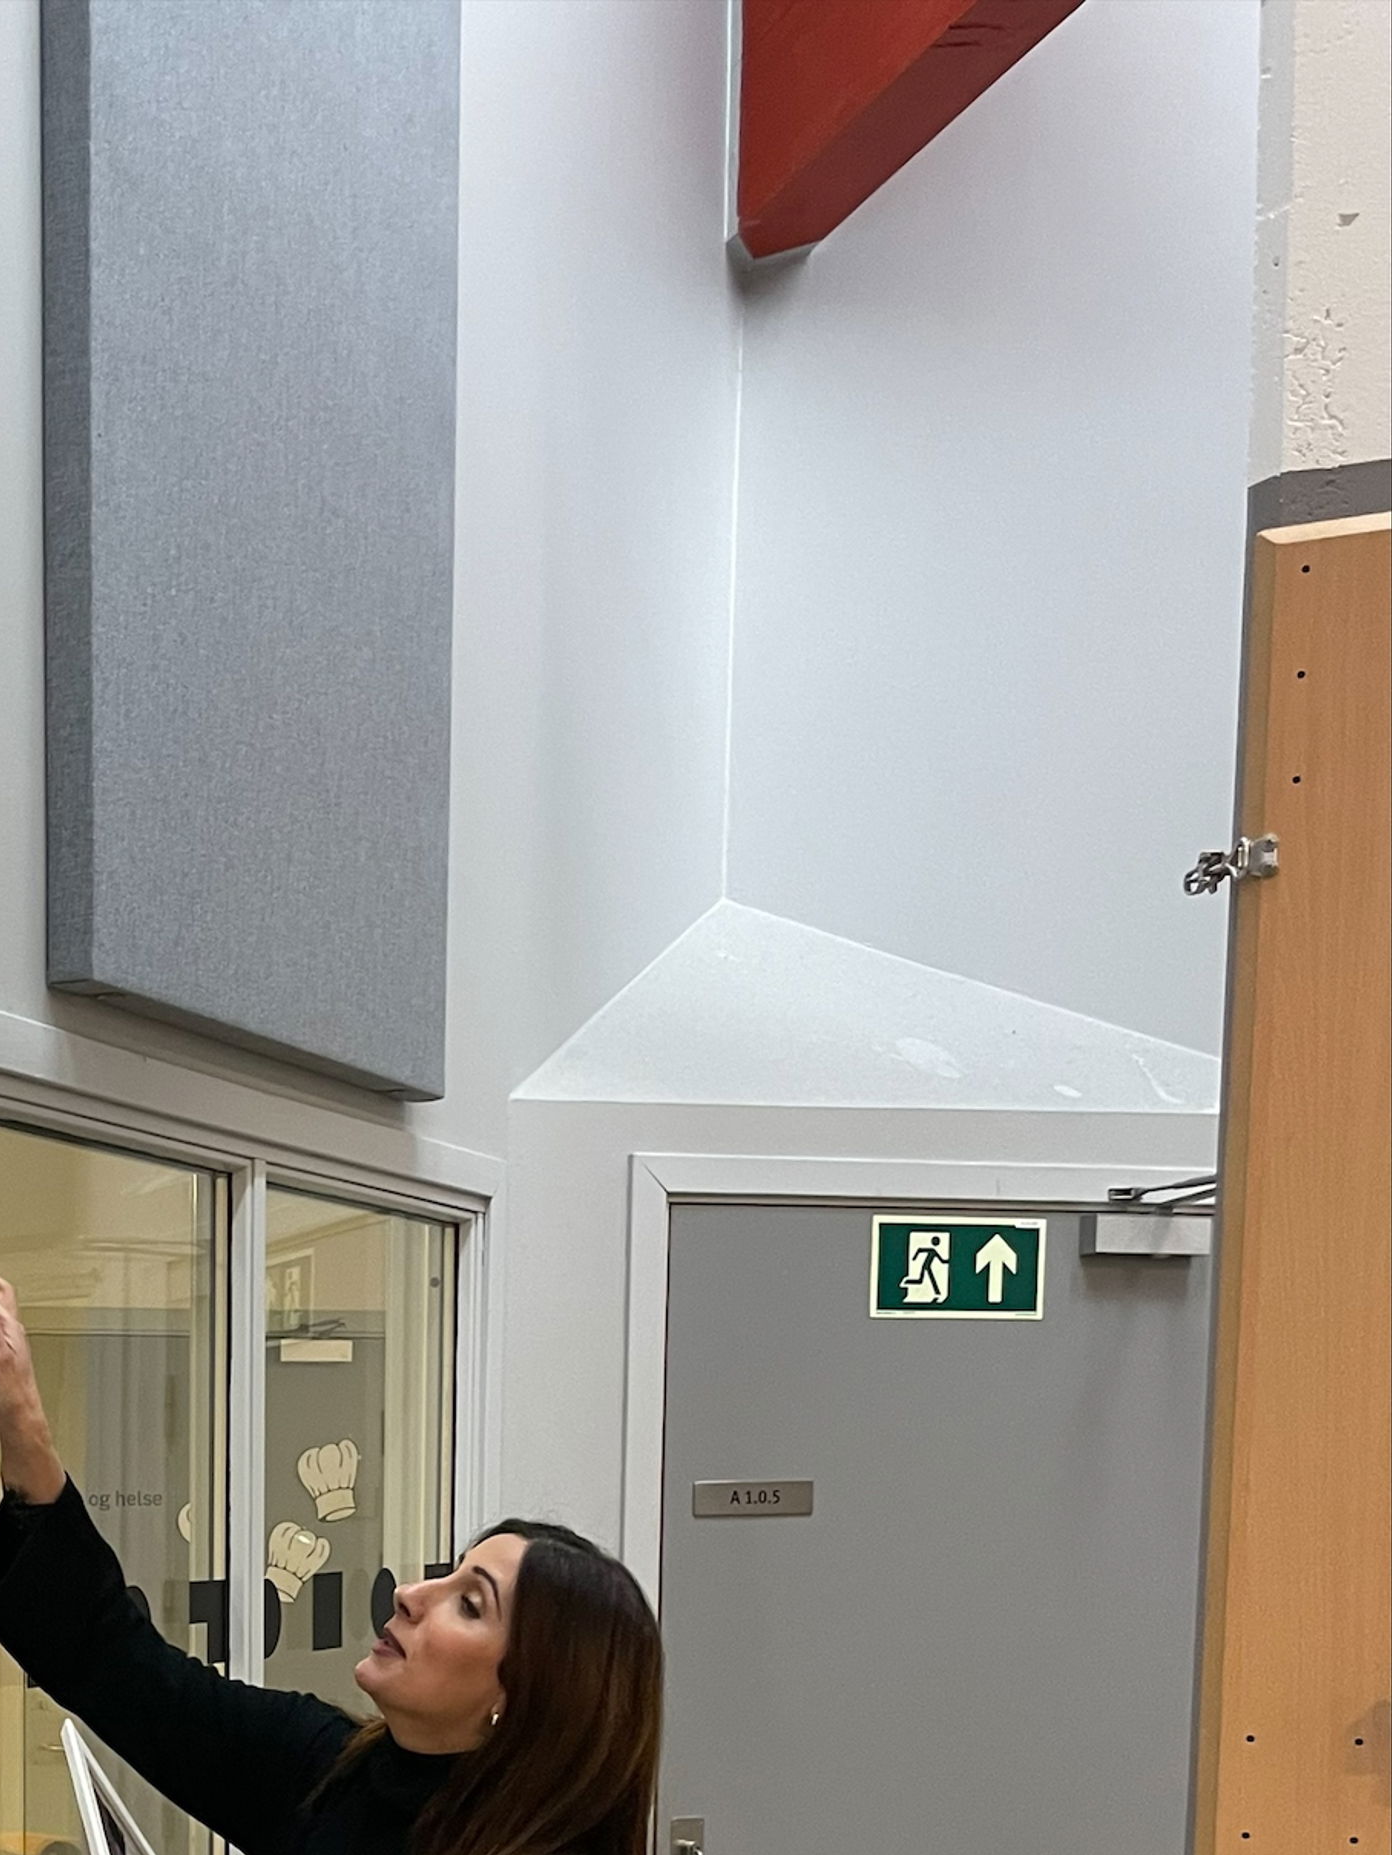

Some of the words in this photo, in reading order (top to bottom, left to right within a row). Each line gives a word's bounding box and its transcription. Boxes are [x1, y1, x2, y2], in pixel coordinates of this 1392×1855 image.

[88, 1493, 111, 1511] og
[115, 1490, 162, 1507] helse
[730, 1490, 741, 1504] A
[745, 1489, 781, 1505] 1.0.5
